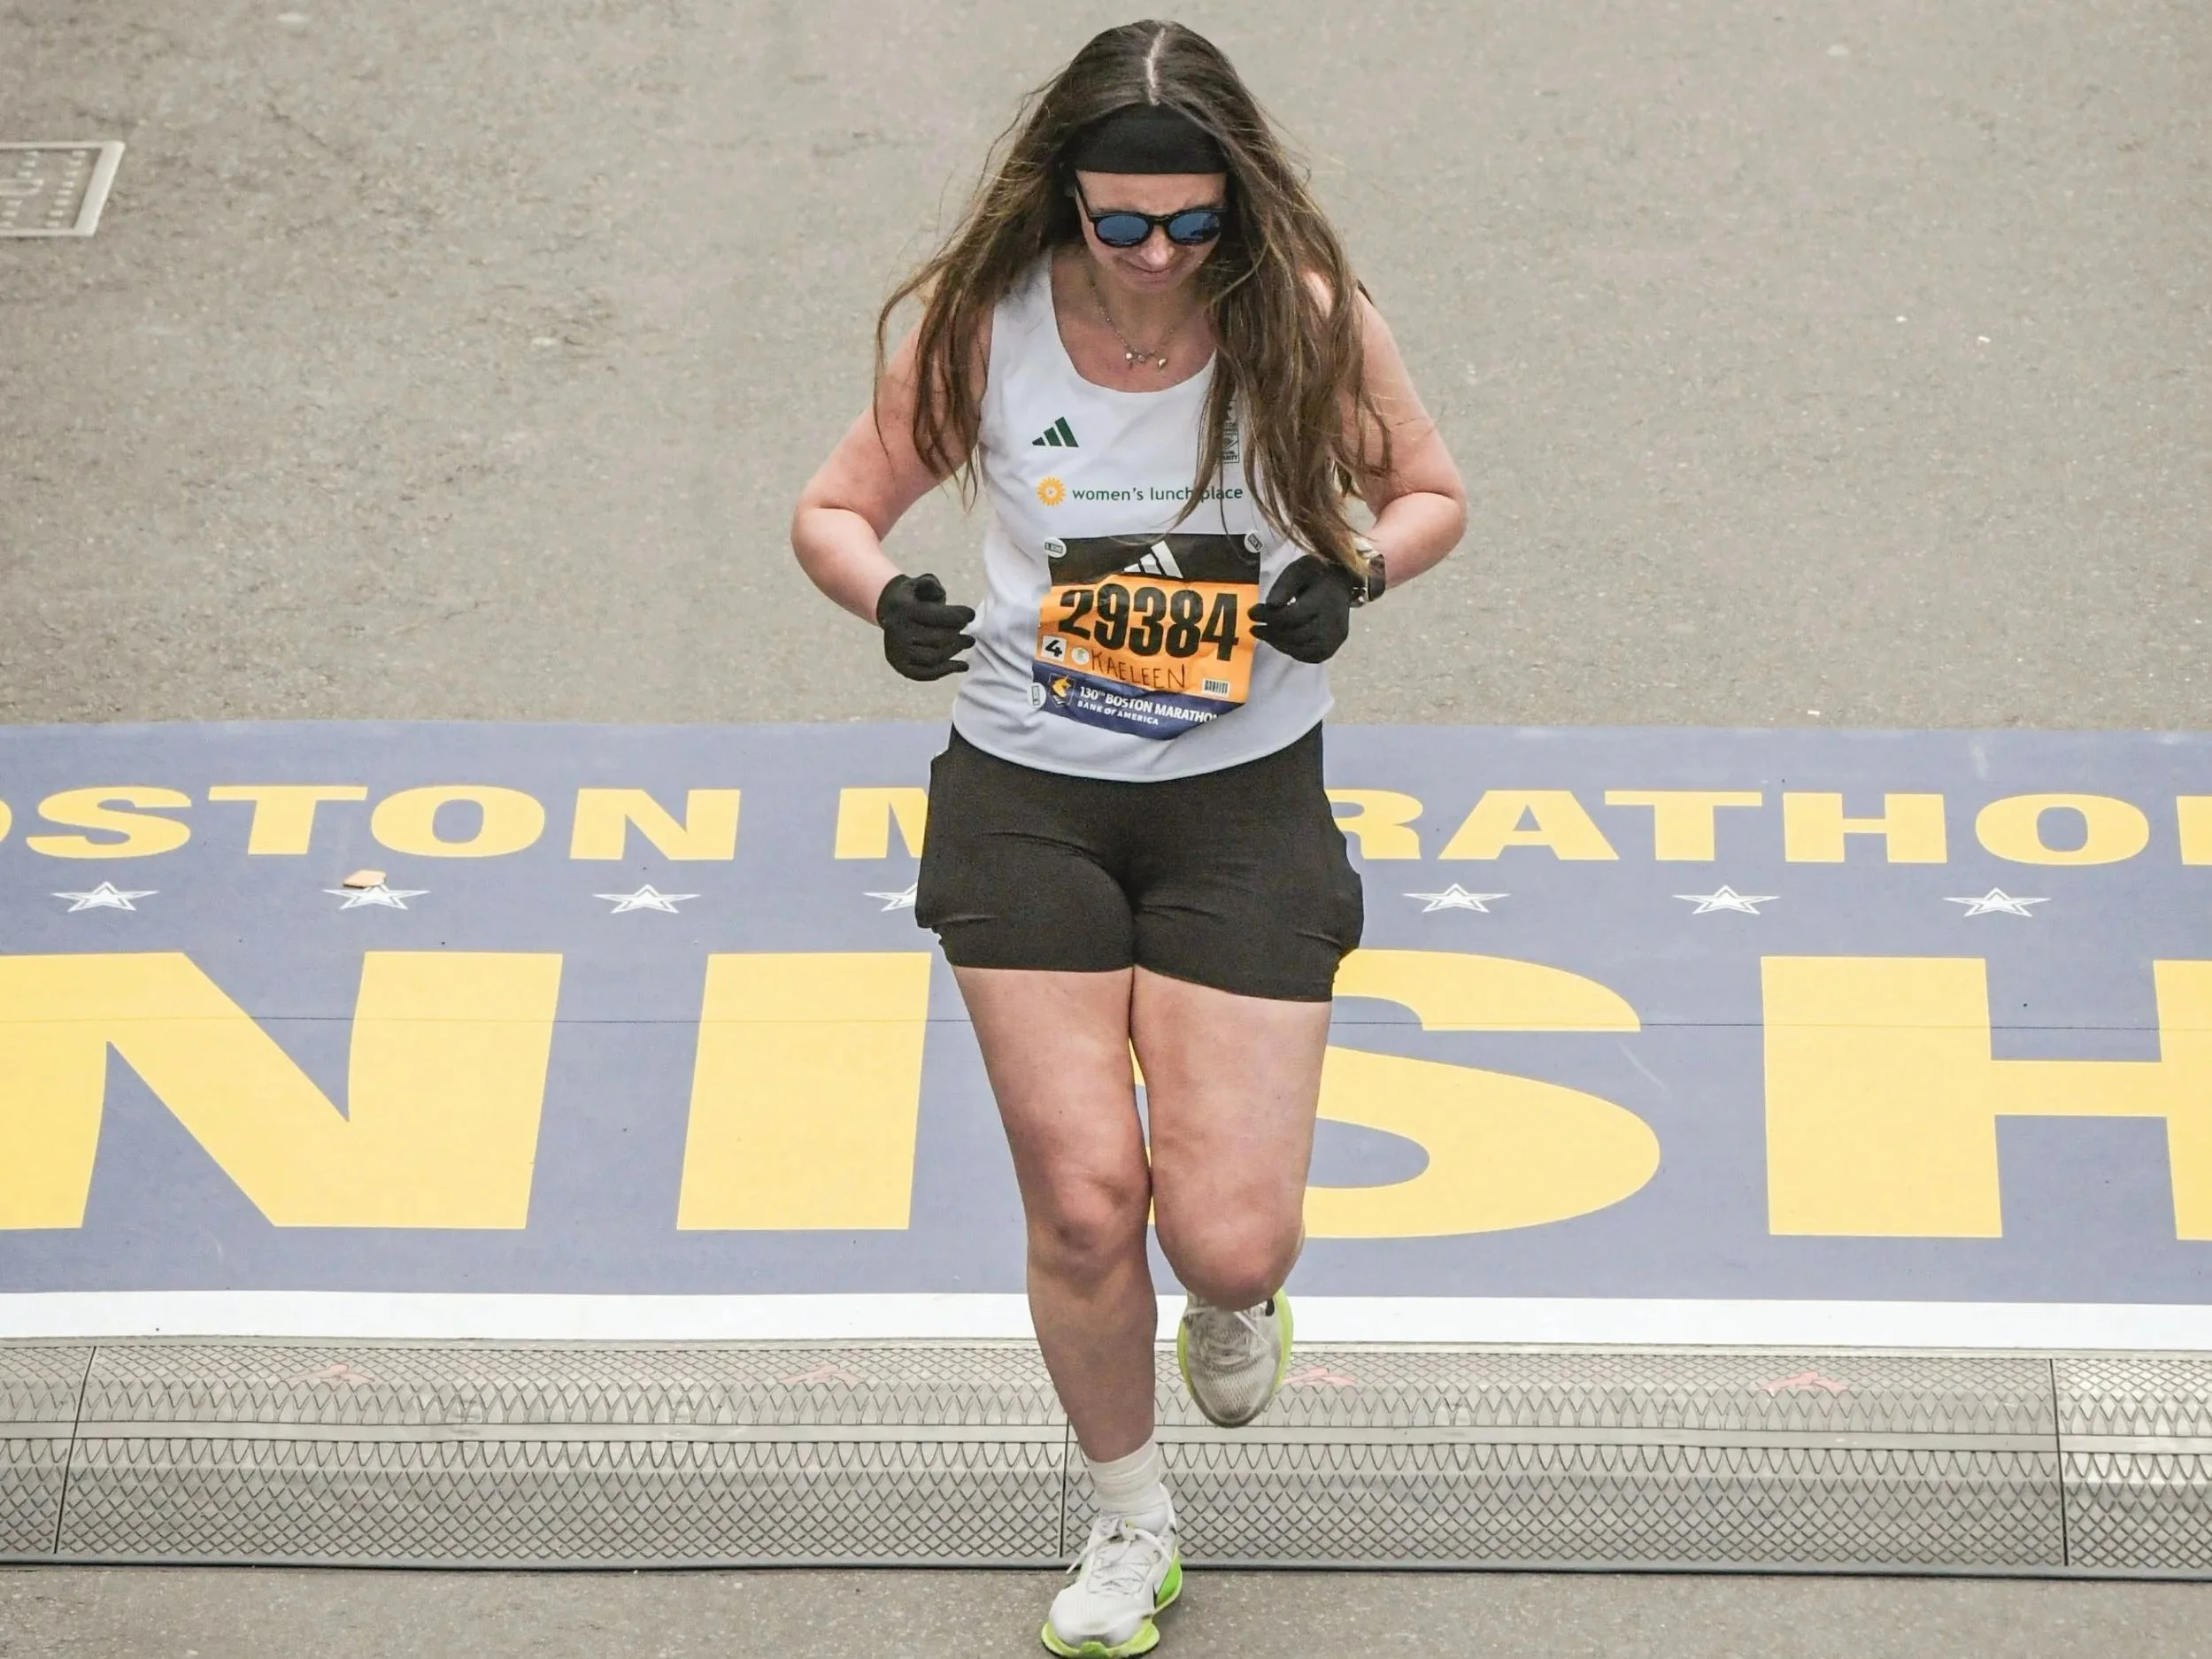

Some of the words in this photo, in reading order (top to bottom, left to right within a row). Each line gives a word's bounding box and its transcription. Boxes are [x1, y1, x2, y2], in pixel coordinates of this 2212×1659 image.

[1072, 487, 1144, 501] women's
[1200, 486, 1244, 503] place
[1058, 583, 1239, 661] 29384
[1044, 639, 1063, 658] 4
[1091, 649, 1186, 689] KAELEEN
[1077, 700, 1103, 713] BANK
[1104, 707, 1117, 716] OF
[1117, 710, 1159, 725] AMERICA
[1106, 693, 1153, 713] BOSTON
[0, 785, 740, 860] STON
